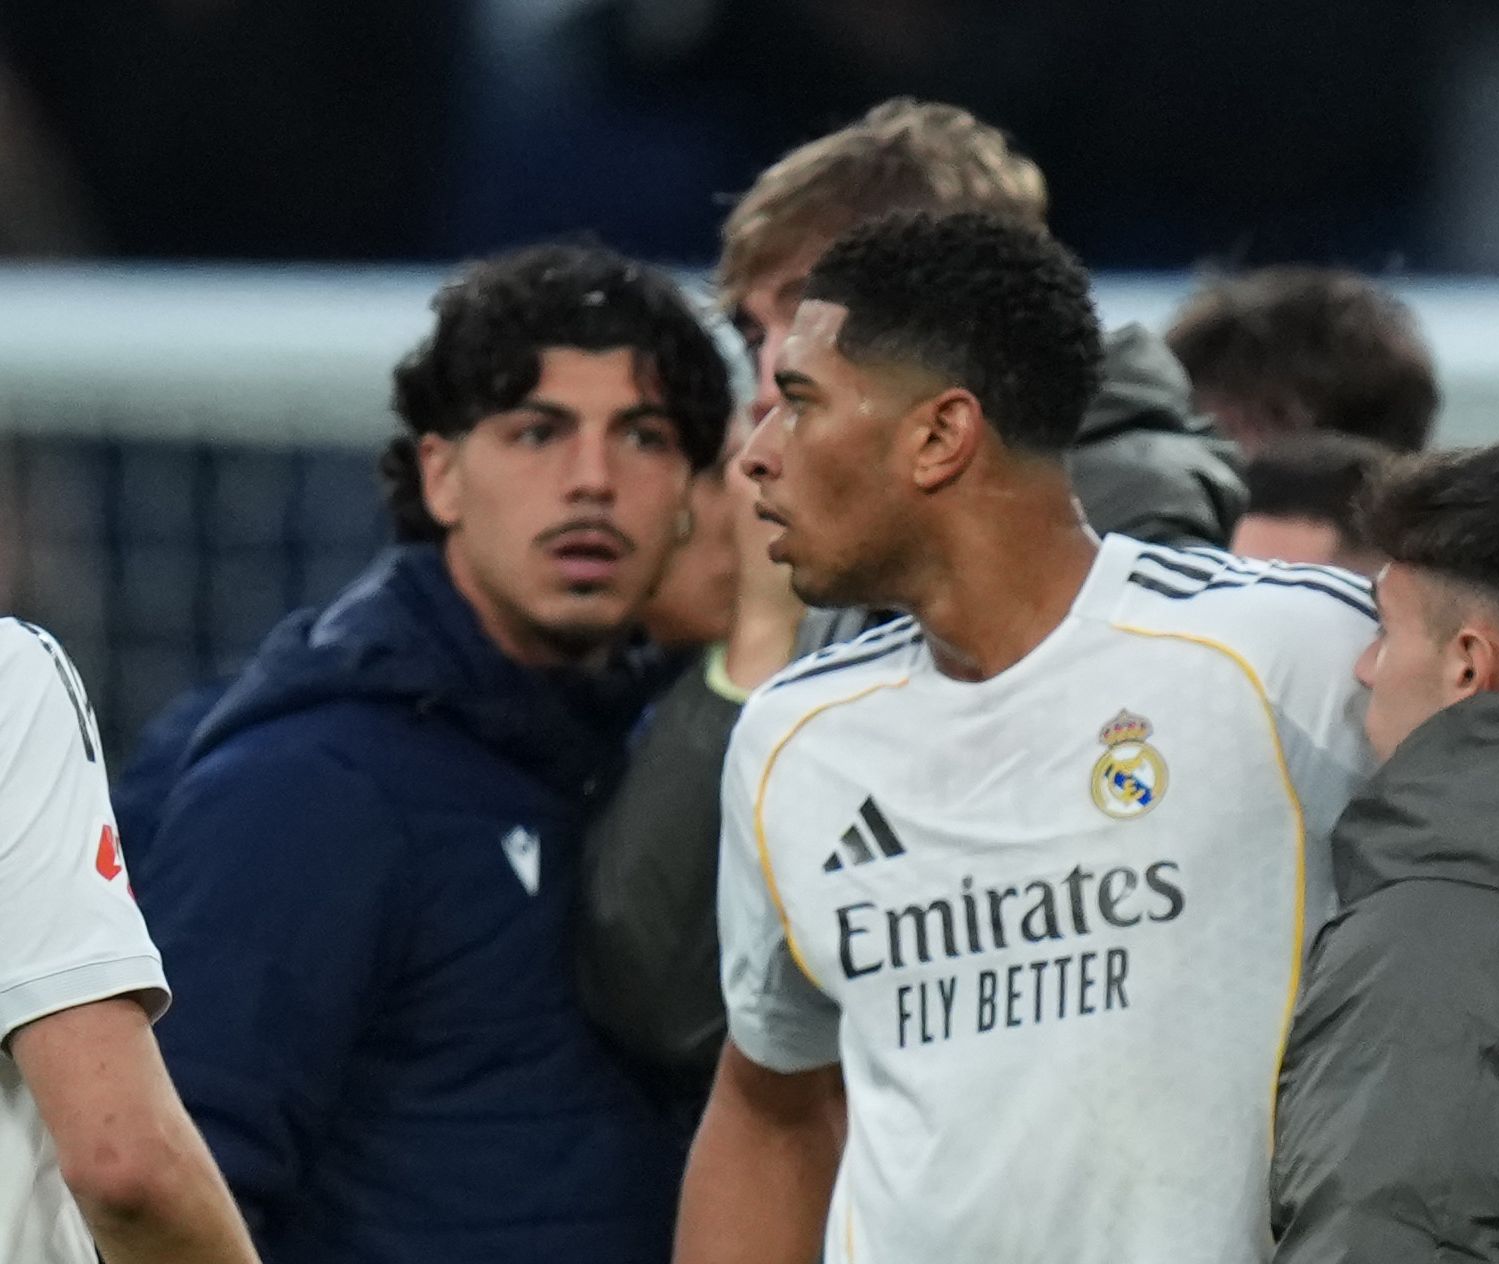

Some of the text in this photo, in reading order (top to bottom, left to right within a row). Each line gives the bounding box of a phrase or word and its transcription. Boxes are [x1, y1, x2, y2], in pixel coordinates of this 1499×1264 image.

[835, 860, 1186, 980] Emirates
[898, 946, 1130, 1049] FLY BETTER
